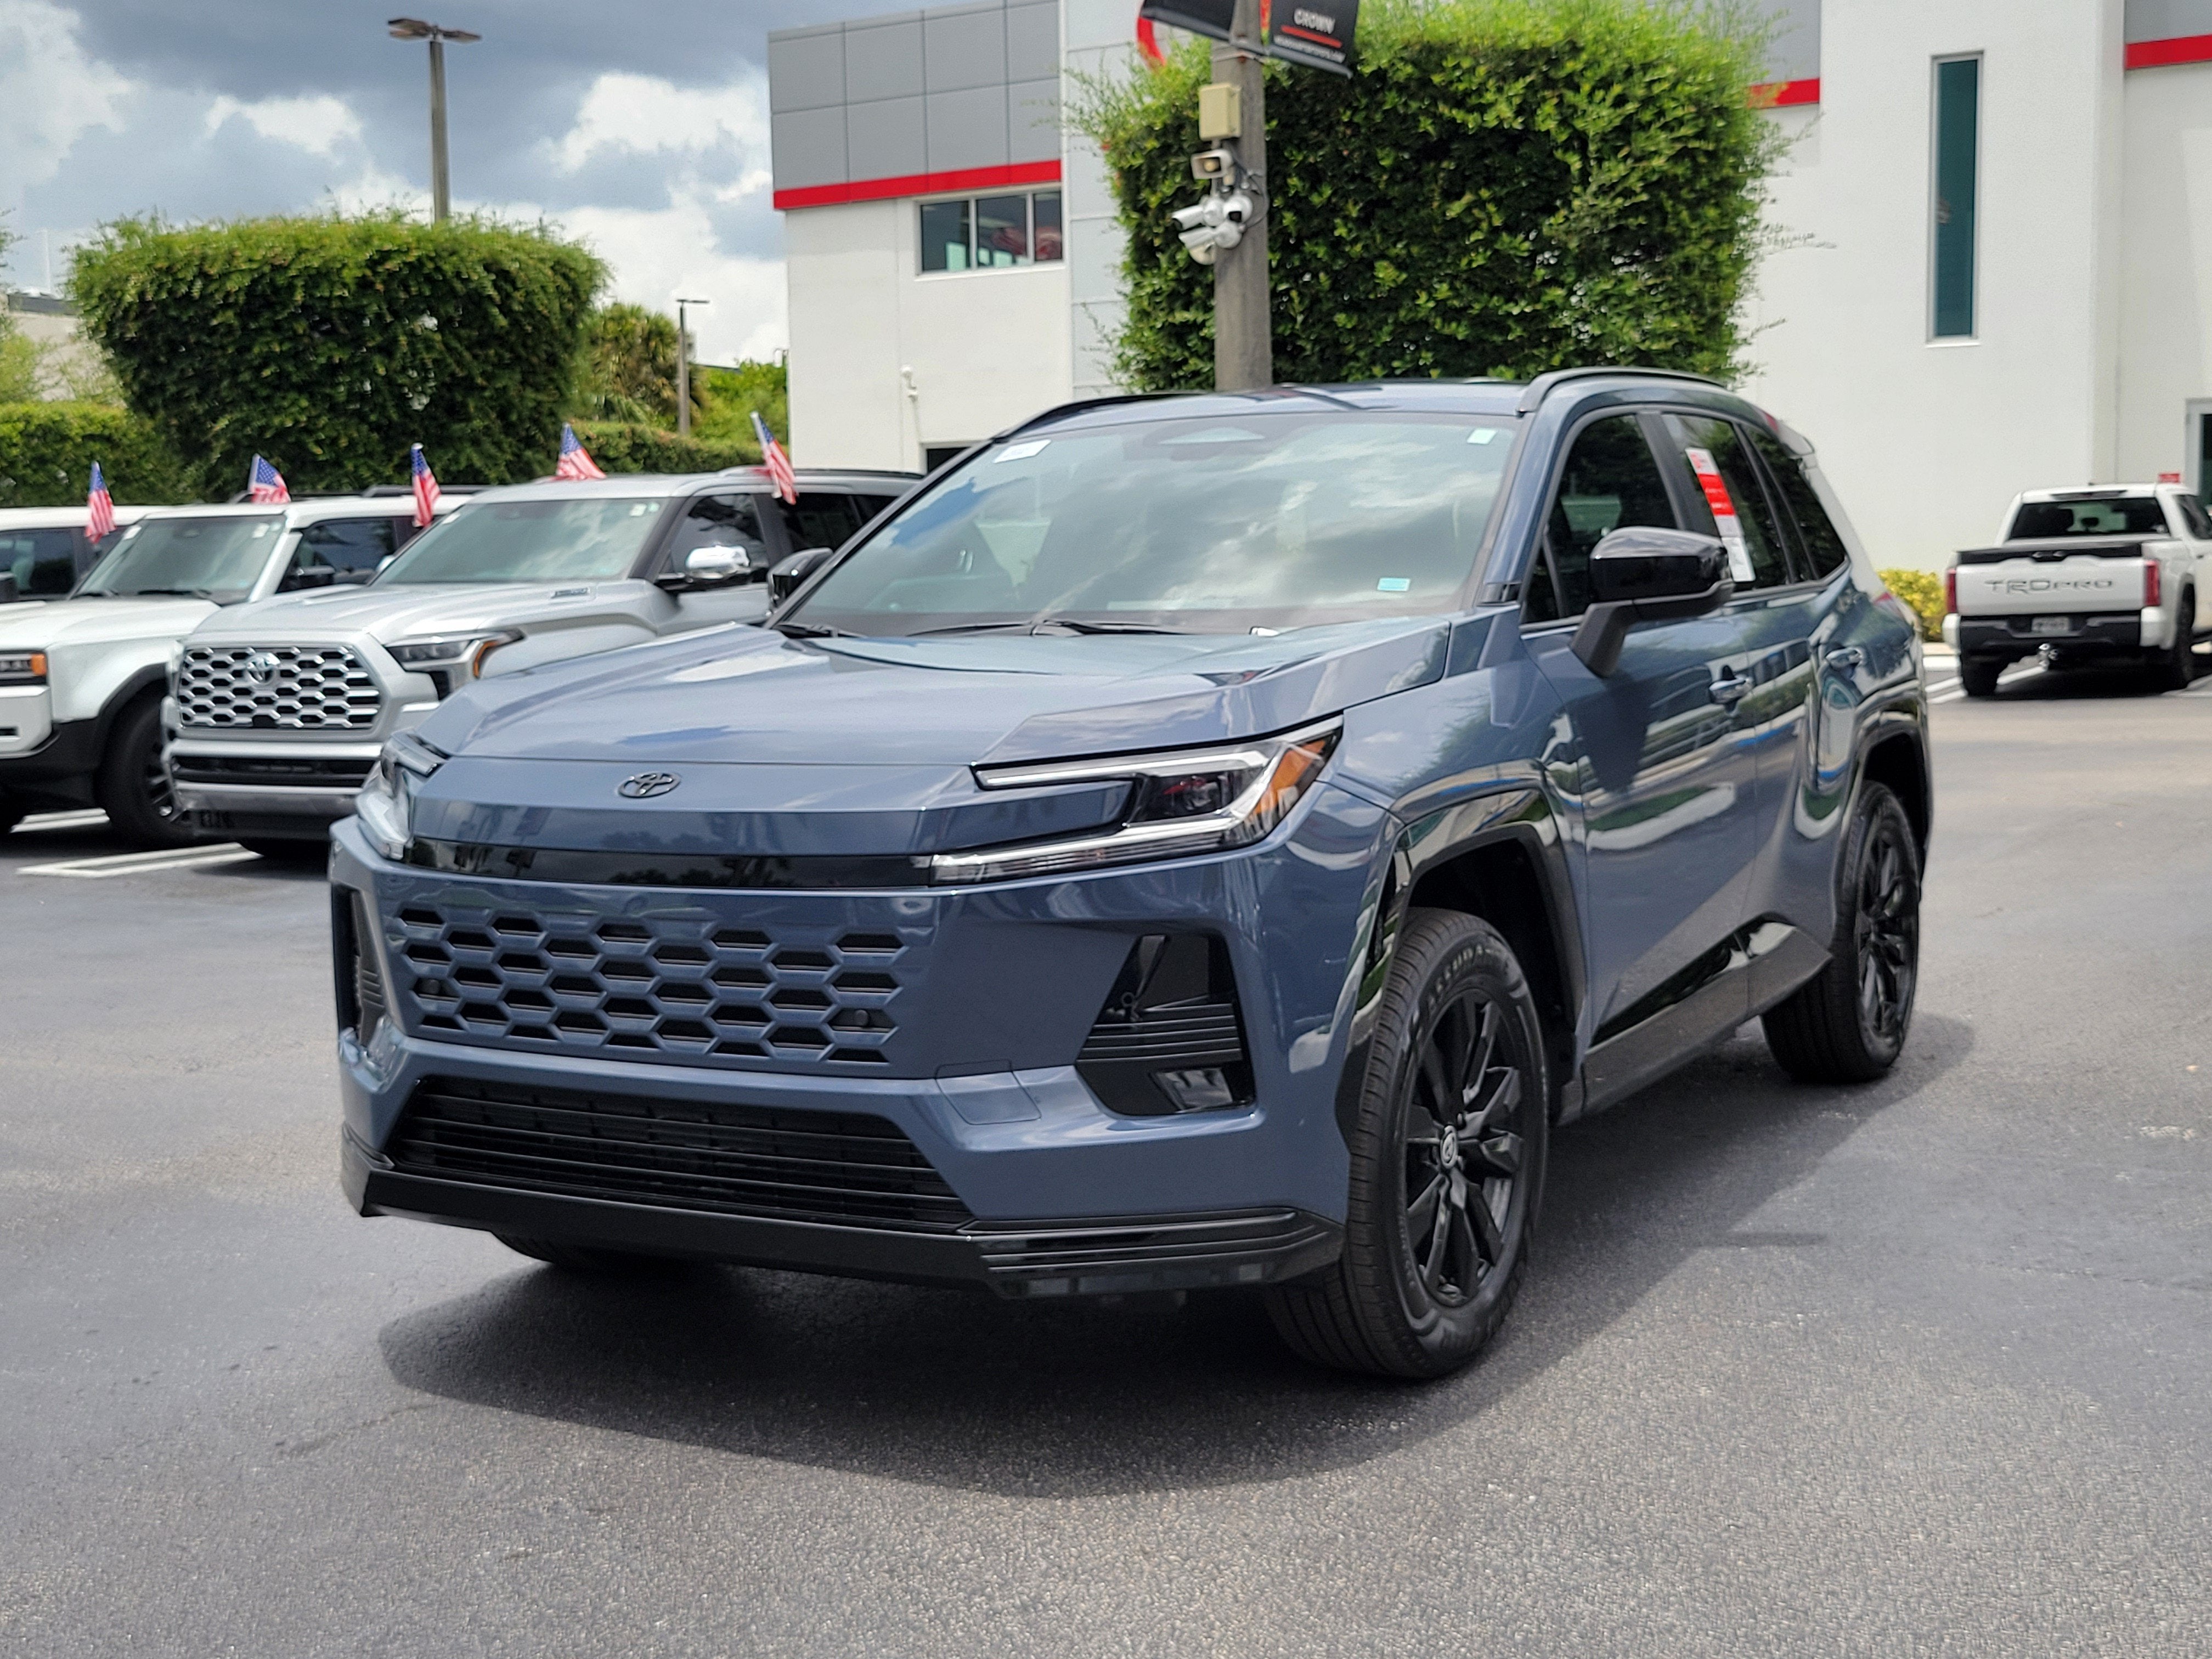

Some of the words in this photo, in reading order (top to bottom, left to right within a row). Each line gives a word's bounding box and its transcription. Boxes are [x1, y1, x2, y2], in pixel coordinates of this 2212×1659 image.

[1294, 8, 1335, 34] CROWN
[1984, 579, 2050, 595] TRD
[2053, 580, 2112, 590] PRO
